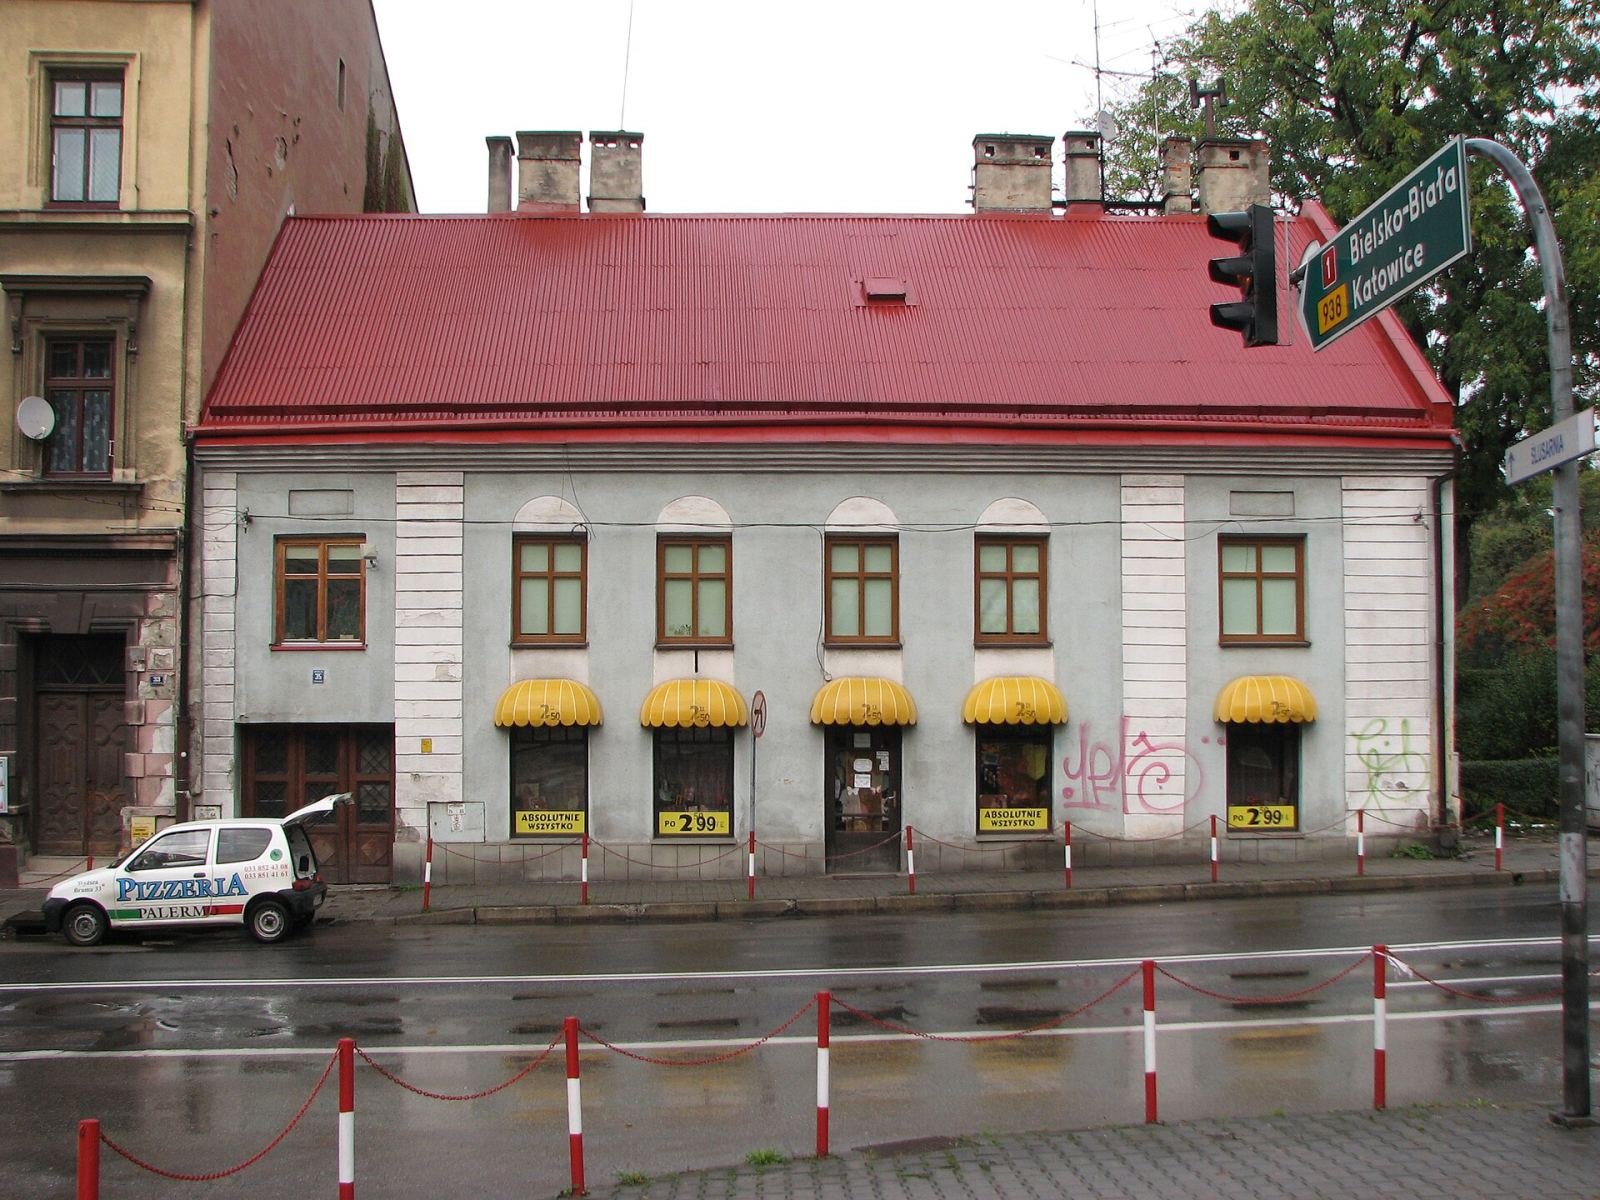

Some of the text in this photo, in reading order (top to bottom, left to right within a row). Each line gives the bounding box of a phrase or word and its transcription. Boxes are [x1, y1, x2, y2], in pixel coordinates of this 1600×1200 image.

[1350, 166, 1456, 265] Bielsko-Biała
[1325, 260, 1332, 280] 1
[1352, 243, 1424, 309] Katowice
[1323, 295, 1342, 325] 938
[521, 813, 580, 822] ABSOLUTNIE
[985, 810, 1041, 819] ABSOLUTNIE
[528, 822, 573, 830] WSZYSTKO
[991, 819, 1036, 828] WSZYSTKO
[244, 864, 256, 872] 033
[116, 873, 248, 901] PIZZERIA
[138, 905, 217, 919] PALERMO
